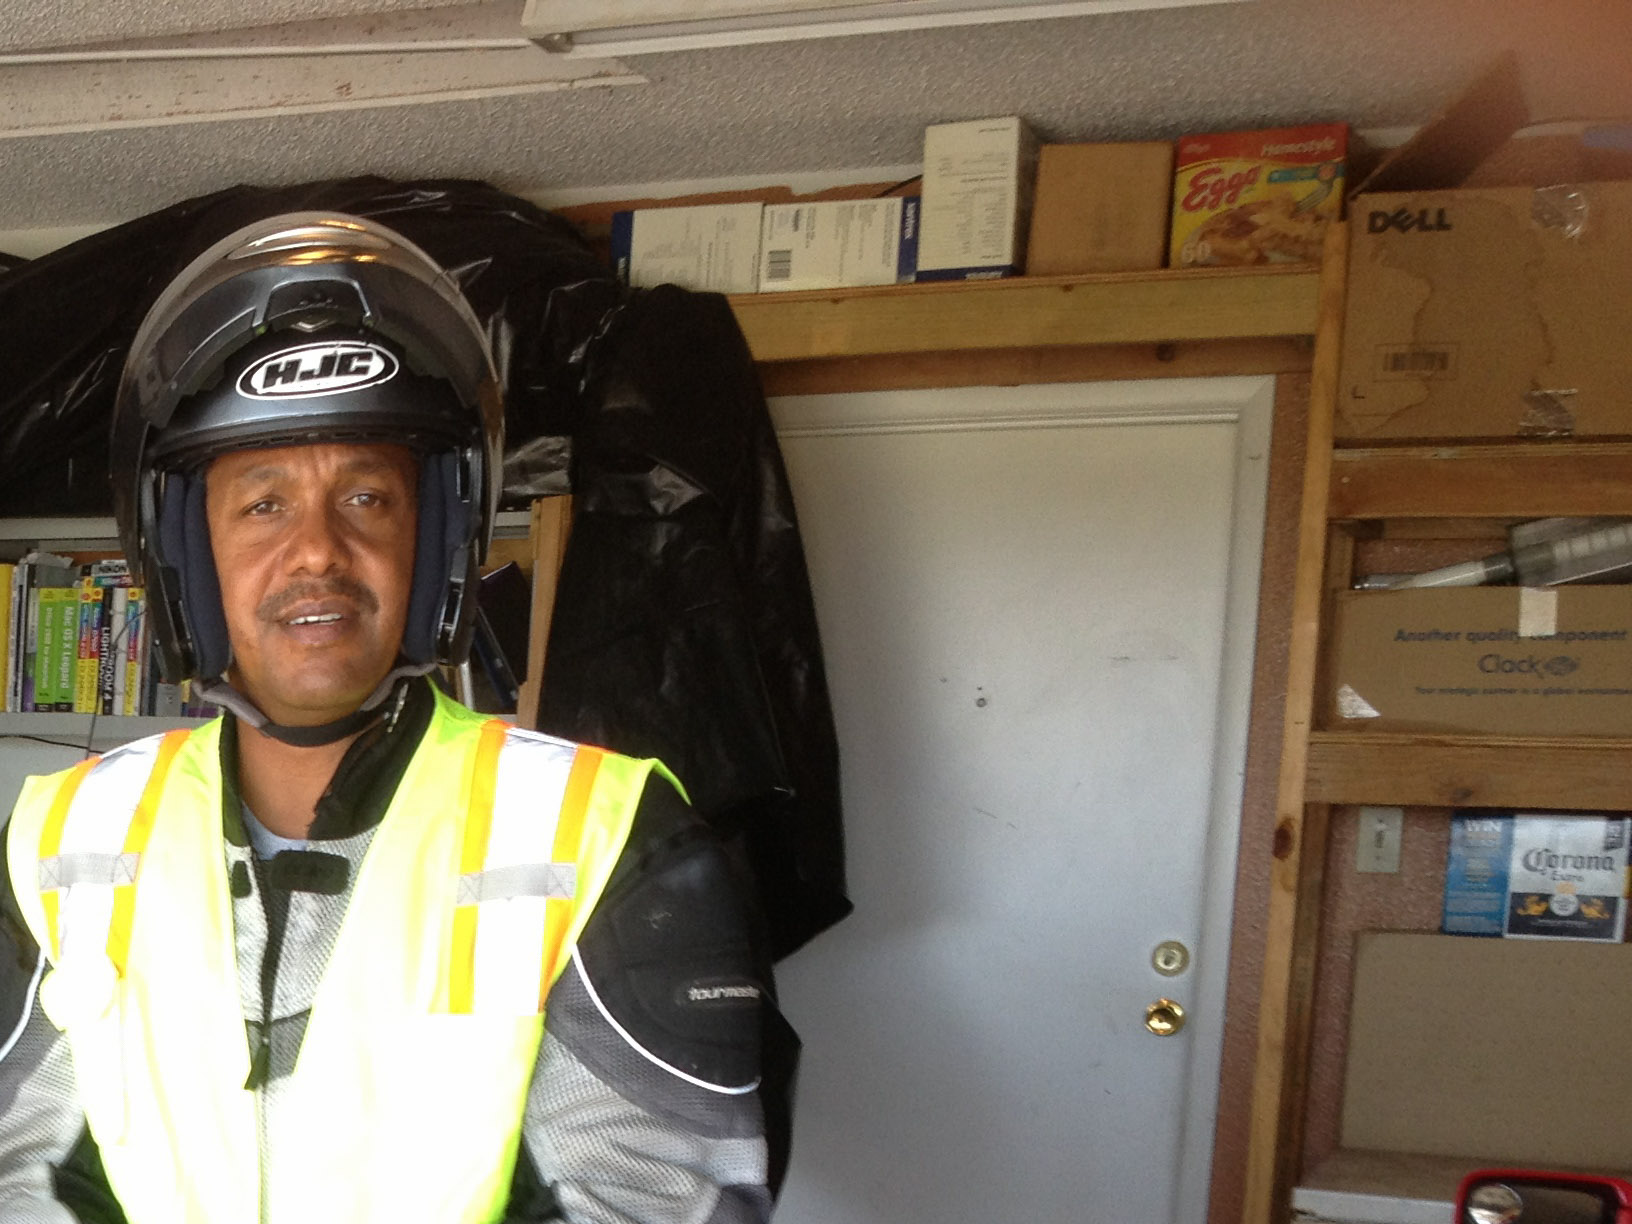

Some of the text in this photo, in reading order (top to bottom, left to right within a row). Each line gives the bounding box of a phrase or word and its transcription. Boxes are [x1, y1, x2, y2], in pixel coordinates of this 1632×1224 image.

[1181, 165, 1263, 212] Eggo
[1368, 207, 1453, 234] DELL
[261, 351, 375, 390] HJC
[64, 606, 74, 627] Mac
[63, 628, 73, 641] OS
[60, 651, 72, 689] Leopard
[1522, 848, 1615, 875] Corona
